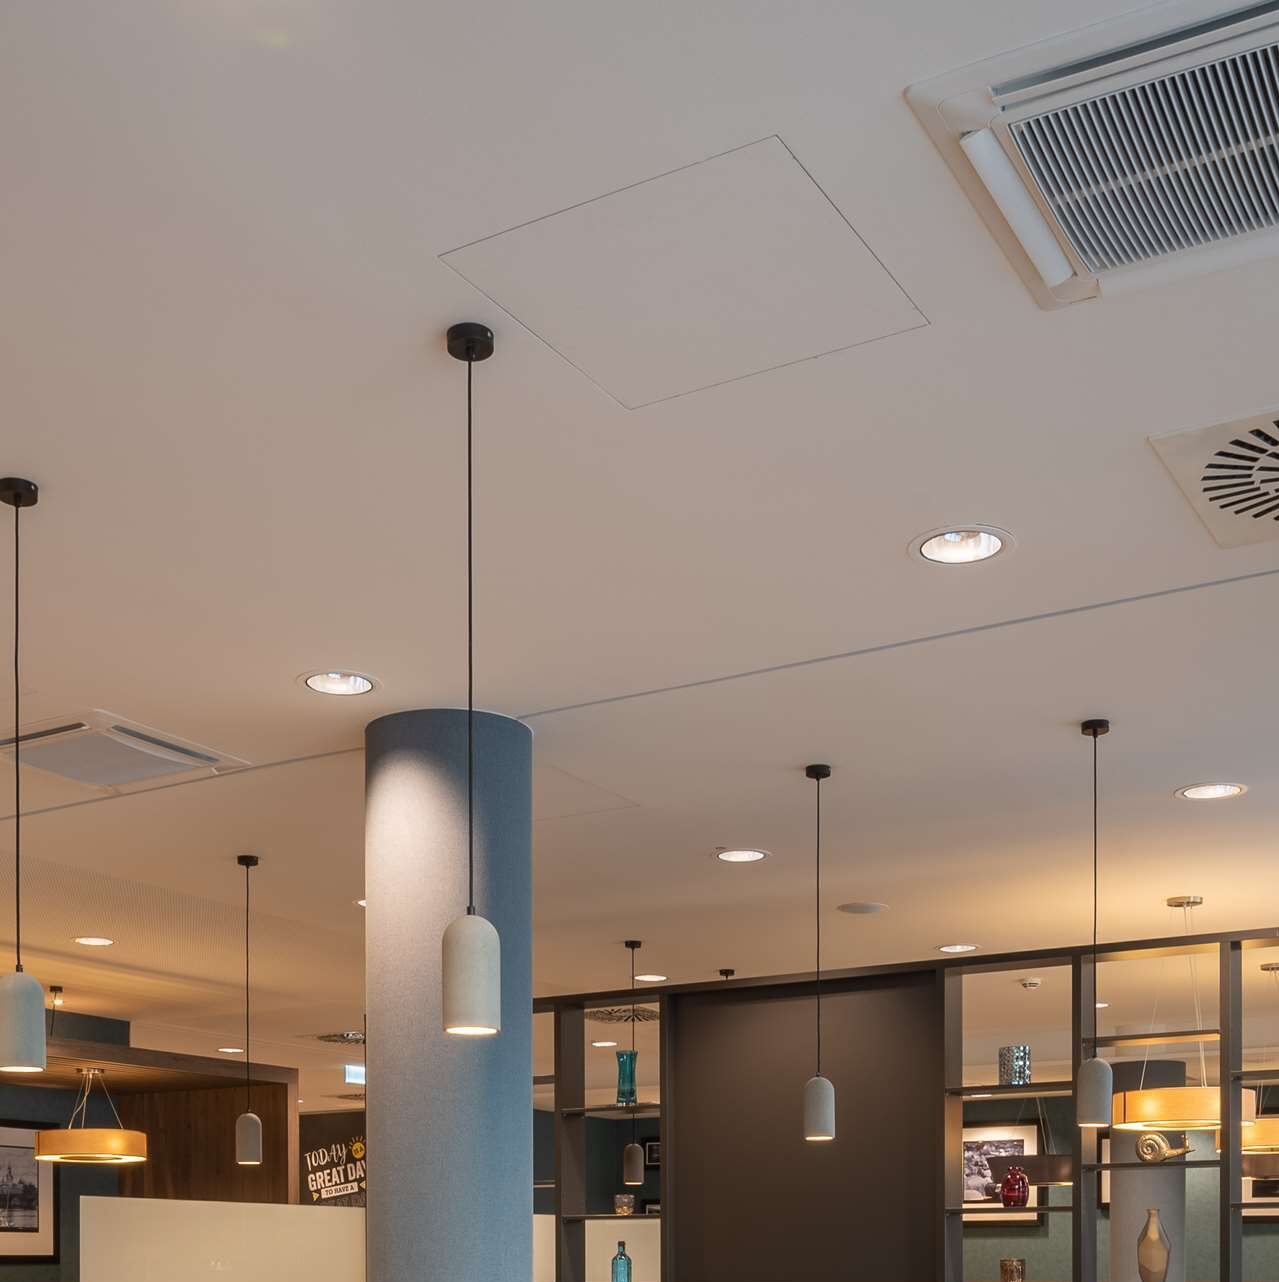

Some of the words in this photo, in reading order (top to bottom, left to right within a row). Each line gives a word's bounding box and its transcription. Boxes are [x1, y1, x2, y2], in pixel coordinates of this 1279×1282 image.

[304, 1143, 347, 1171] TODAY
[308, 1165, 345, 1191] GREAT
[325, 1188, 334, 1196] TO
[334, 1185, 349, 1194] HAVE
